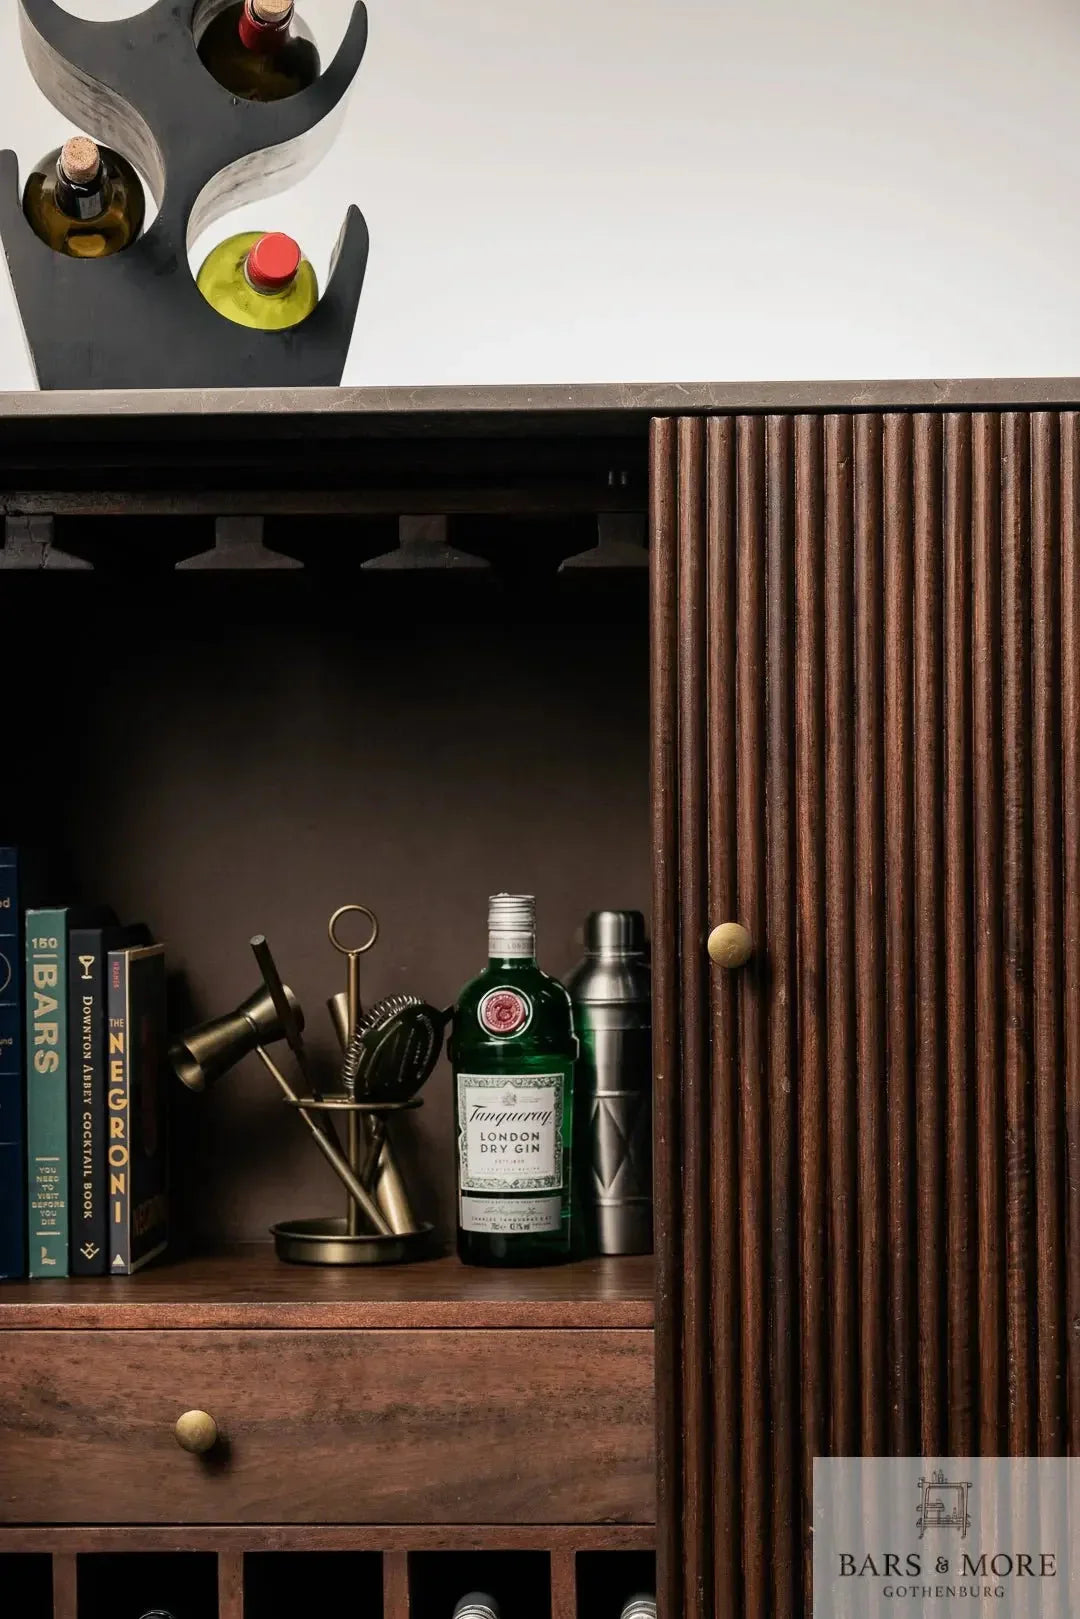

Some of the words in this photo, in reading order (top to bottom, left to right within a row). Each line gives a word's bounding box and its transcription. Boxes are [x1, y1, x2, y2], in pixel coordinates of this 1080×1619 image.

[32, 937, 58, 949] 150
[33, 964, 60, 1074] BARS
[82, 995, 94, 1059] DOWNTON
[109, 1018, 125, 1028] THE
[82, 1064, 94, 1105] ABBEY
[469, 1104, 553, 1127] Tanqueray
[107, 1032, 129, 1223] NEGRONI
[480, 1131, 540, 1142] LONDON
[82, 1111, 93, 1177] COCKTAIL
[480, 1143, 508, 1154] DRY
[514, 1143, 540, 1154] GIN
[36, 1175, 60, 1183] NEED
[83, 1182, 93, 1219] BOOK
[41, 1218, 56, 1226] DIE
